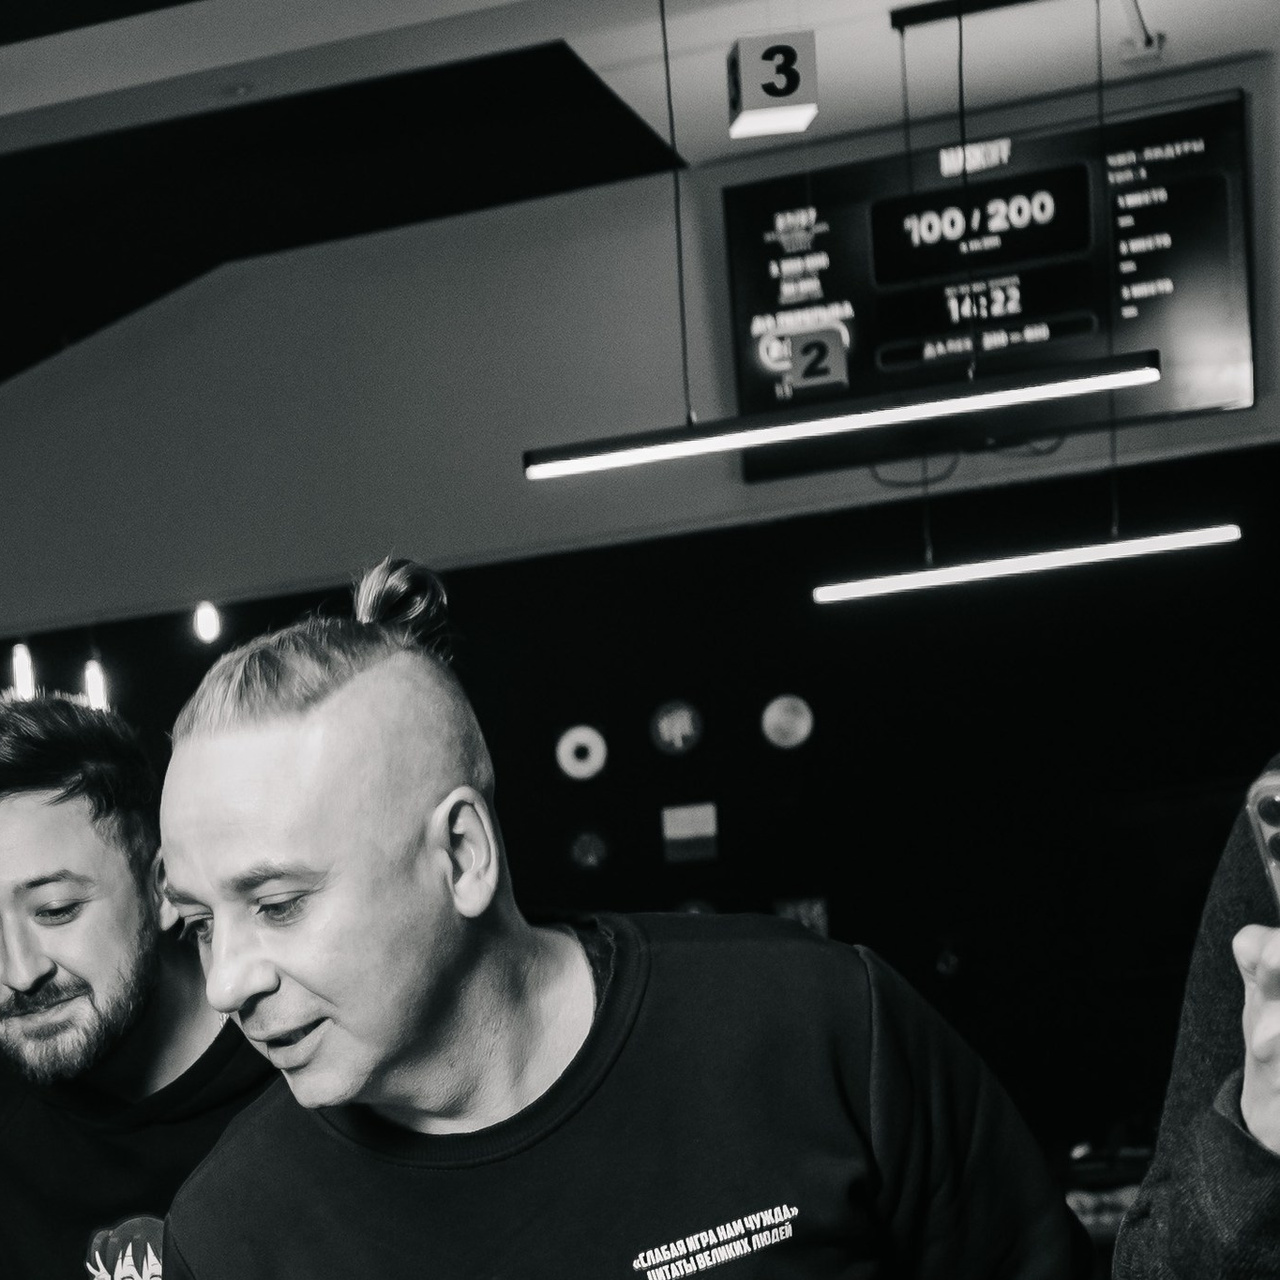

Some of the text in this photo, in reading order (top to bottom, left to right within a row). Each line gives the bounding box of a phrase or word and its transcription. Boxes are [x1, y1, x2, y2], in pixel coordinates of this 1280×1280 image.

[761, 44, 801, 98] 3
[800, 340, 832, 379] 2
[686, 1229, 718, 1252] ИГРА
[716, 1219, 745, 1241] НАМ
[695, 1237, 752, 1270] ВЕЛИКИХ
[751, 1222, 793, 1250] ЛЮДЕЙ
